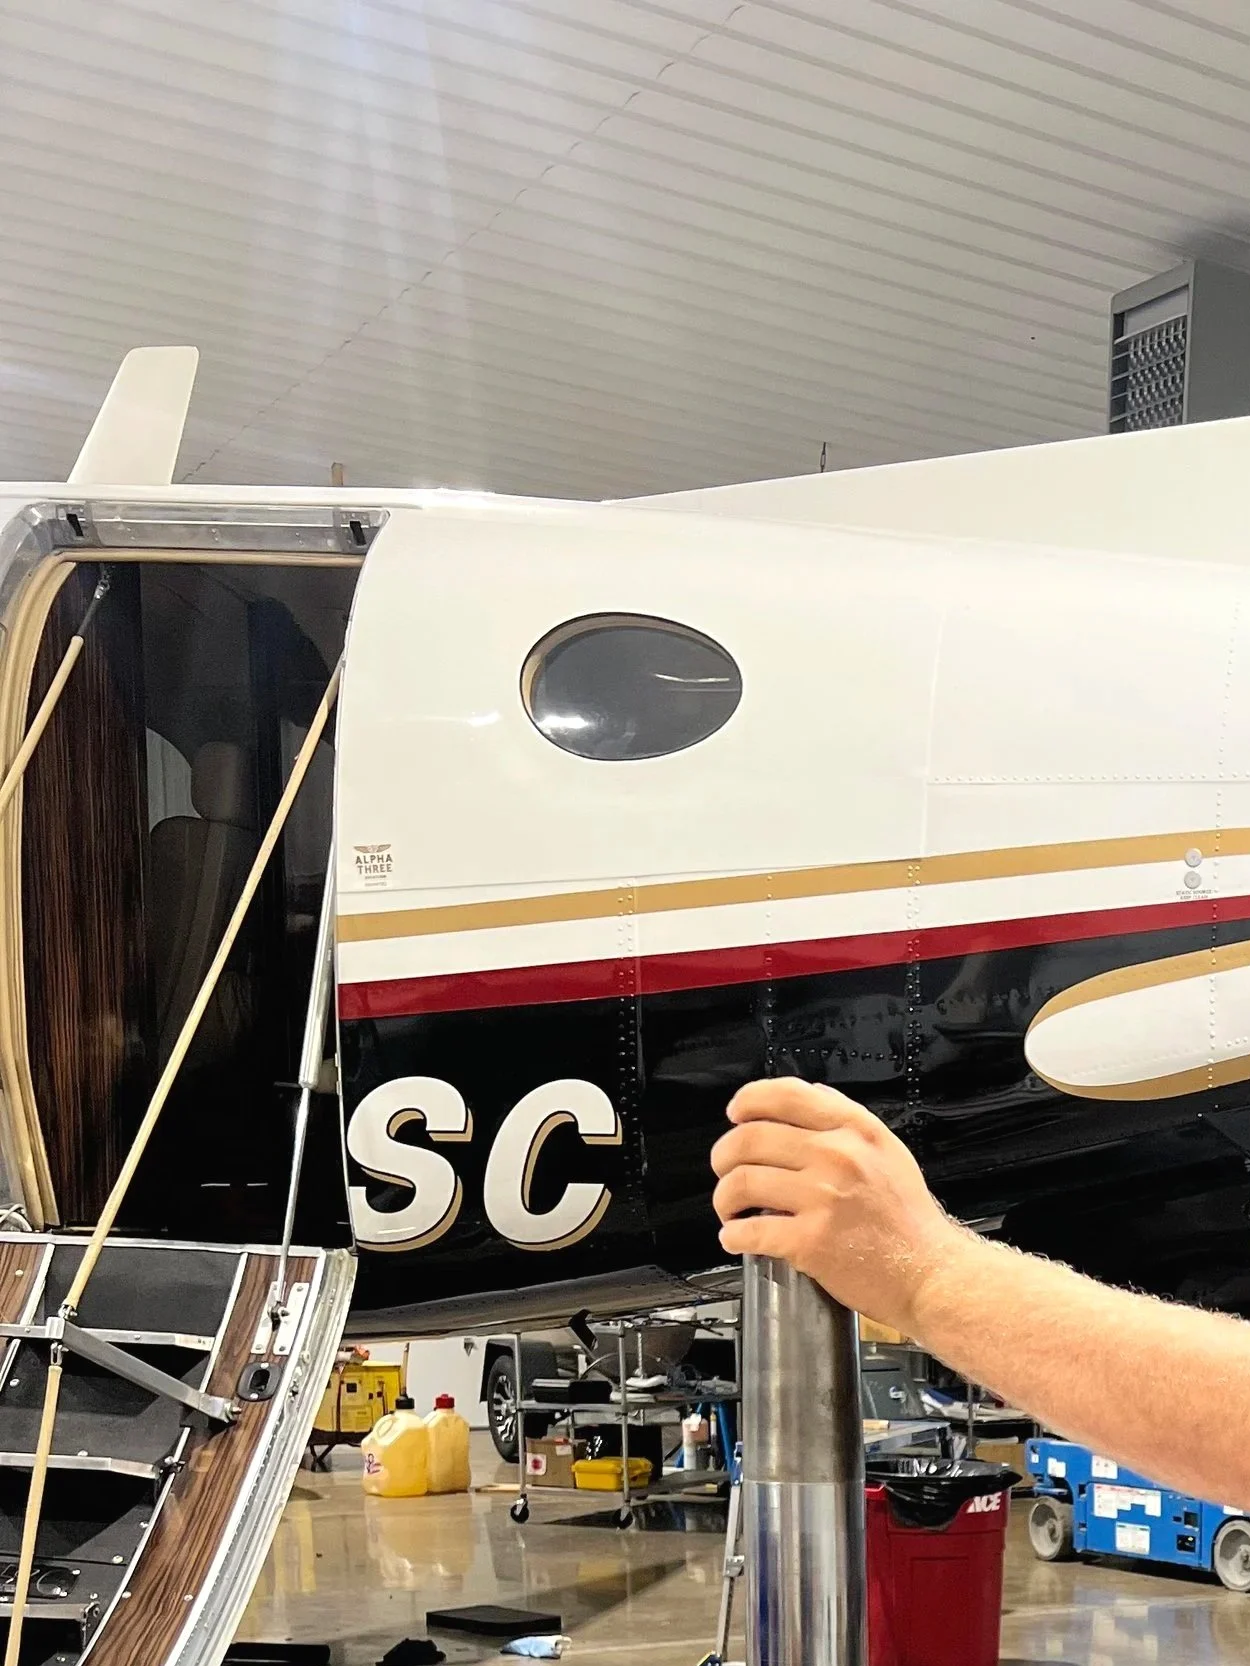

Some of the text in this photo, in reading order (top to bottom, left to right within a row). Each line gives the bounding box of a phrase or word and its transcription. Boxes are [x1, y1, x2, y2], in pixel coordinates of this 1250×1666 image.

[355, 854, 393, 865] ALPHA
[357, 864, 392, 875] THREE
[347, 1076, 623, 1252] SC
[966, 1491, 1003, 1514] ACE
